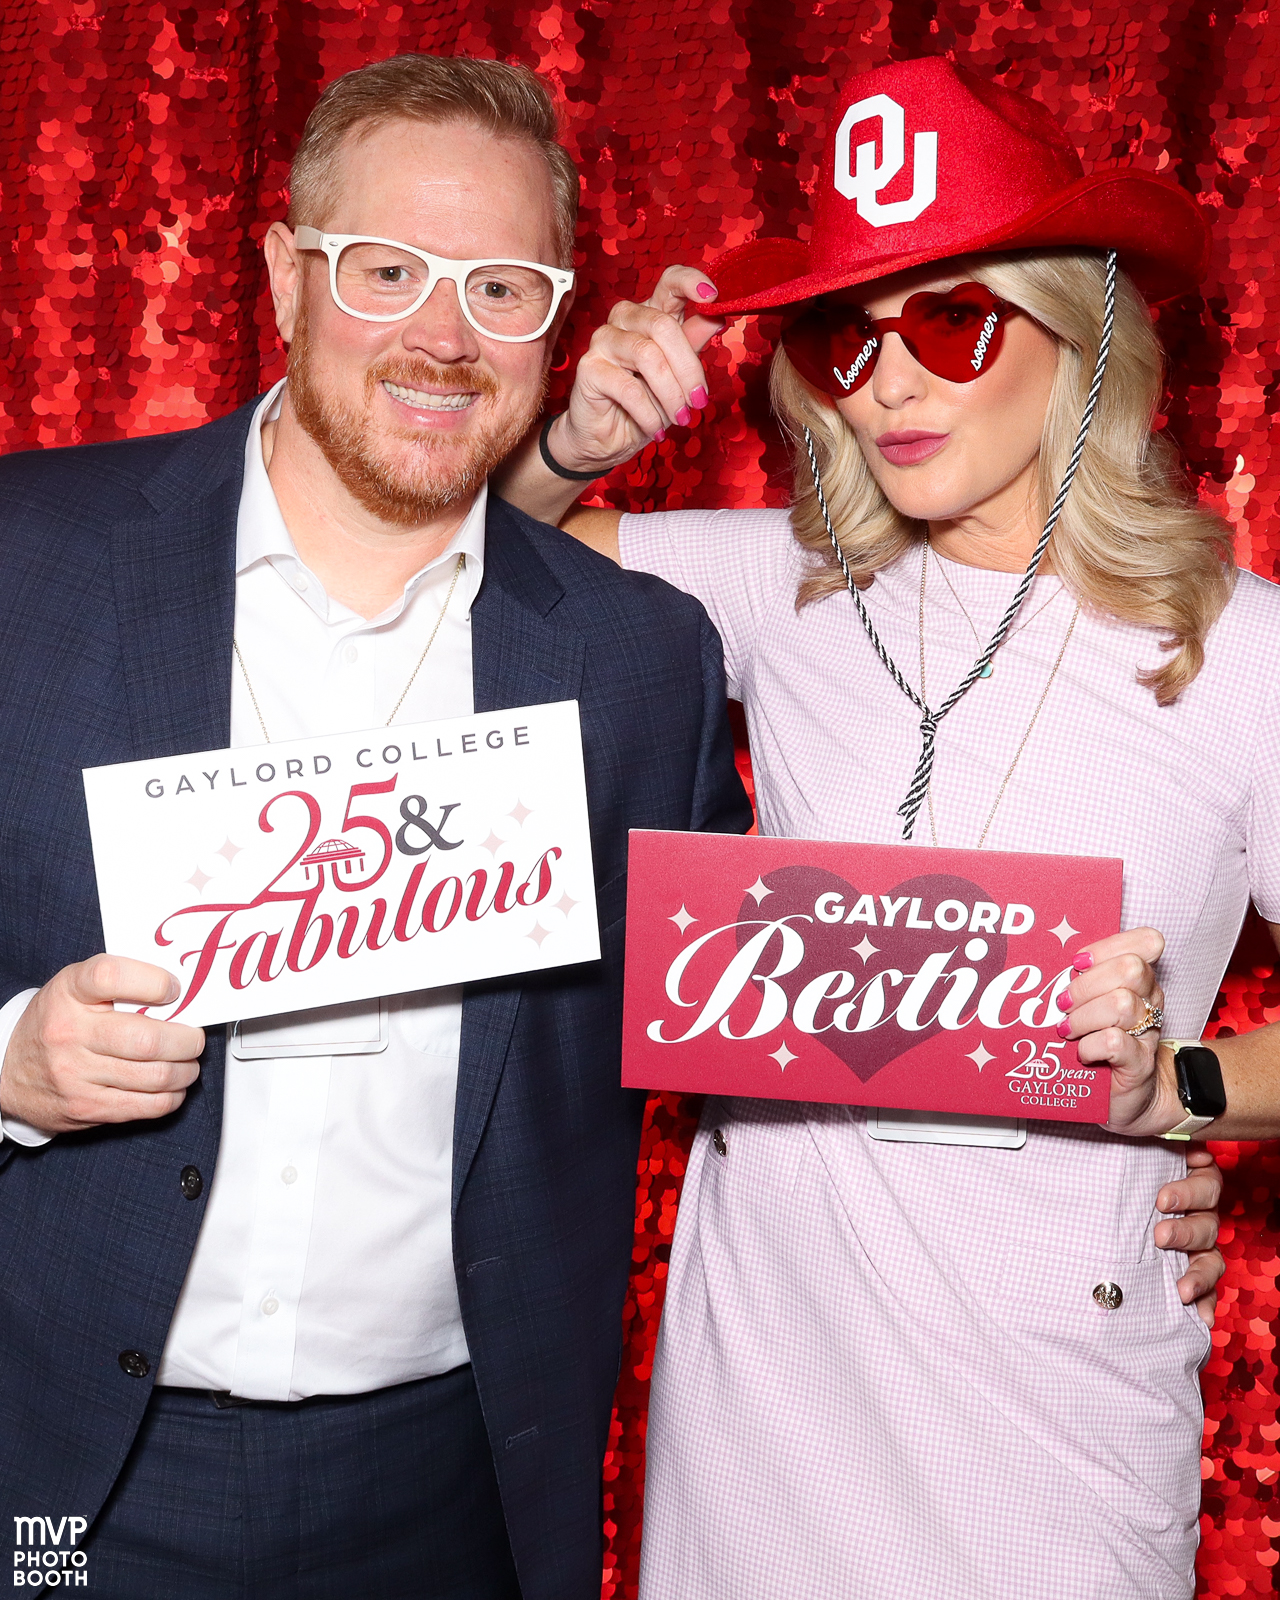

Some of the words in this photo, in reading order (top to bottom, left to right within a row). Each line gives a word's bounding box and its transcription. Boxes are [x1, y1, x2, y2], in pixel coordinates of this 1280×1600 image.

[834, 93, 938, 228] OU
[833, 337, 878, 390] boomer
[970, 311, 998, 371] sooner
[145, 755, 332, 799] GAYLORD
[357, 725, 531, 767] COLLEGE
[135, 847, 562, 1021] Fabulous
[813, 891, 1035, 935] GAYLORD
[646, 914, 1077, 1044] Besties
[1004, 1039, 1067, 1080] 25
[1056, 1068, 1097, 1082] years
[1008, 1079, 1091, 1098] GAYLORD
[1020, 1095, 1077, 1108] COLLEGE
